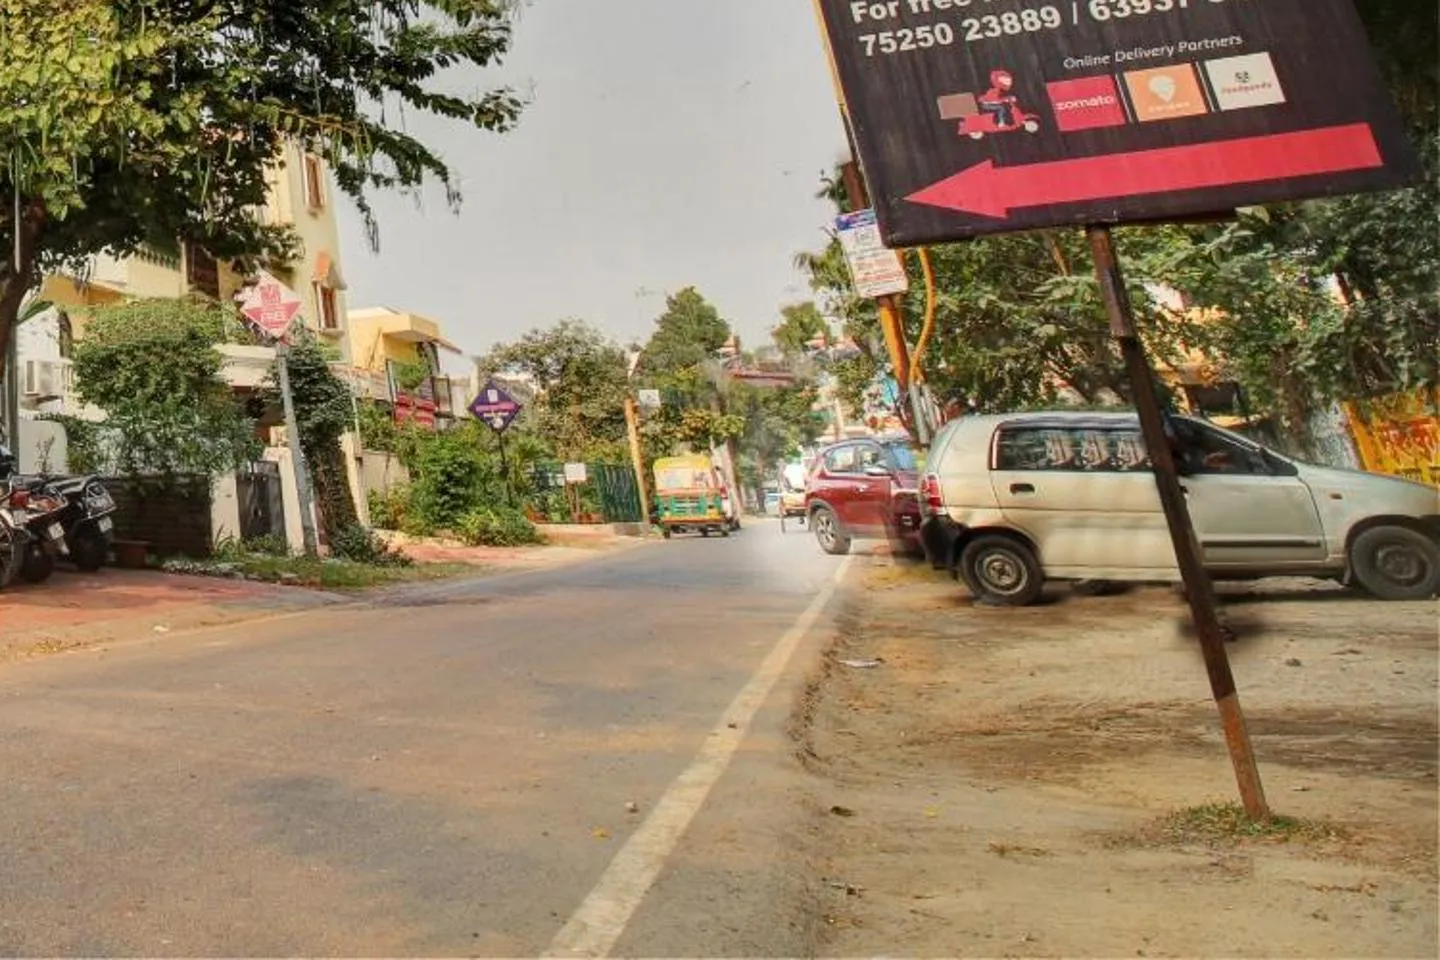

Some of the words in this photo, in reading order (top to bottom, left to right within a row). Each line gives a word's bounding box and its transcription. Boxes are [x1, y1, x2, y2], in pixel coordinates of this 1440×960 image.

[850, 0, 900, 24] For
[858, 22, 954, 56] 75250
[961, 5, 1061, 41] 23889
[1063, 54, 1111, 70] Online
[1115, 44, 1175, 63] Delivery
[1178, 34, 1243, 53] Partners
[1055, 95, 1114, 111] zomato
